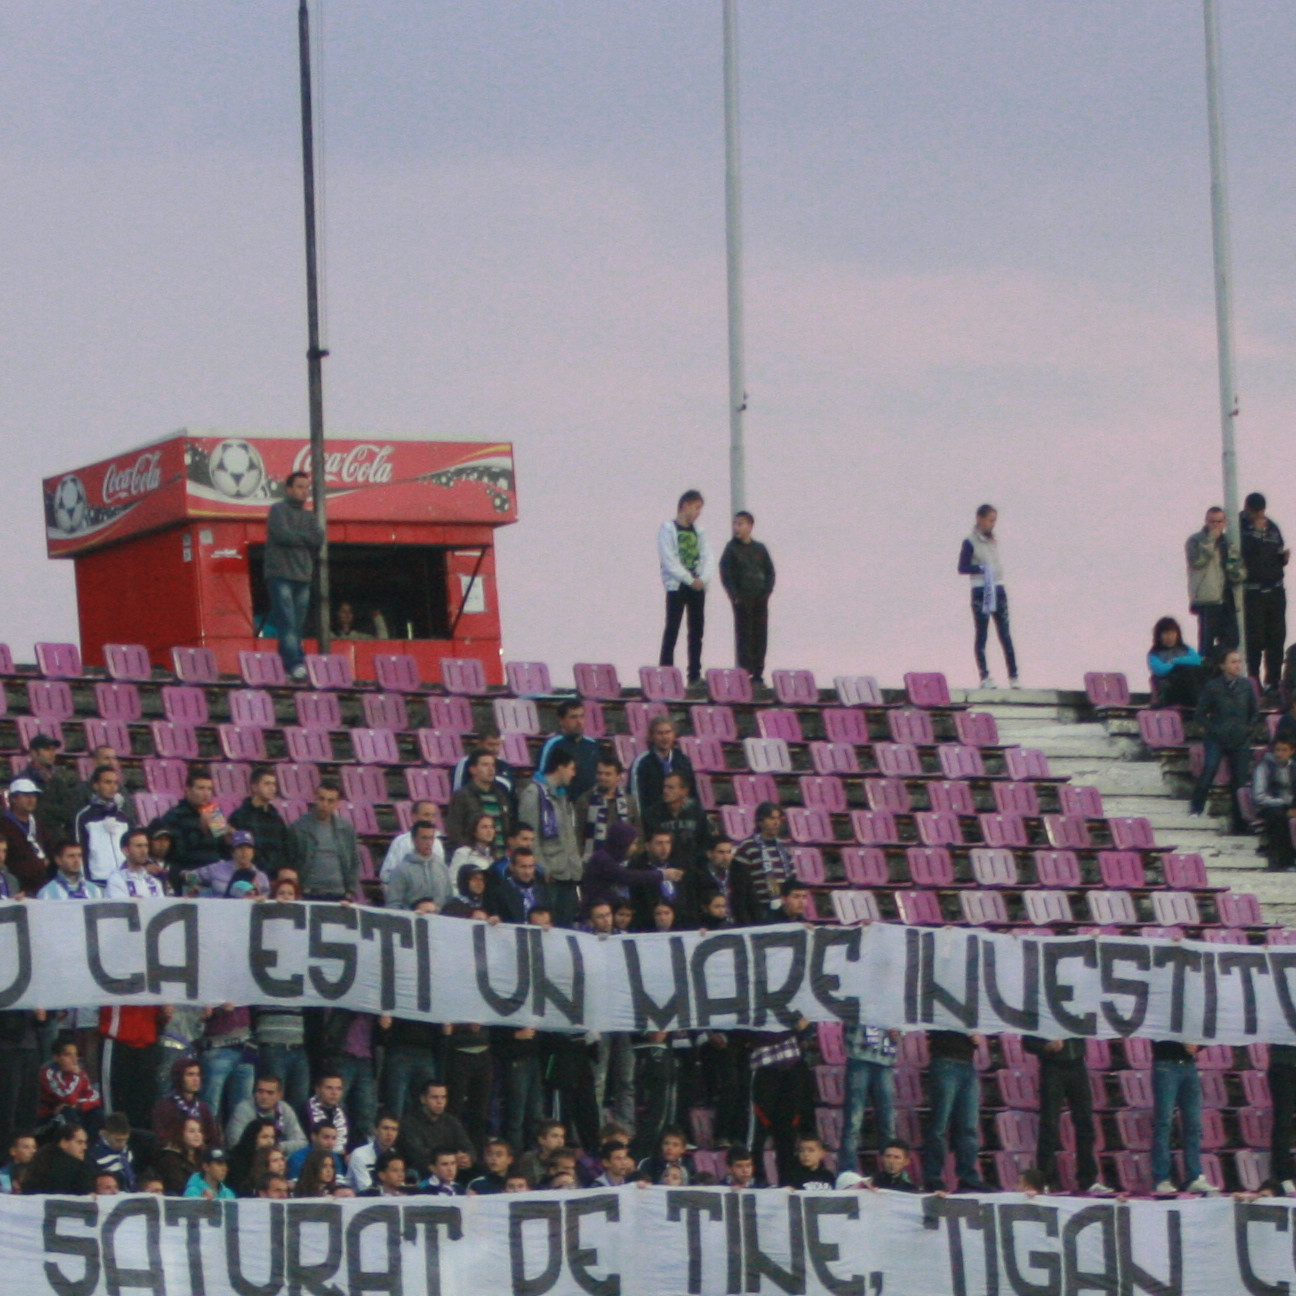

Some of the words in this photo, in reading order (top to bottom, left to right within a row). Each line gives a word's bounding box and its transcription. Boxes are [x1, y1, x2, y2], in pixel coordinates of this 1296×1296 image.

[104, 452, 162, 504] Coca-Cola
[292, 443, 394, 483] Coa-Cola
[85, 902, 199, 999] CA
[249, 902, 431, 1013] ESTI
[473, 924, 585, 1025] UN
[623, 928, 860, 1031] MARE
